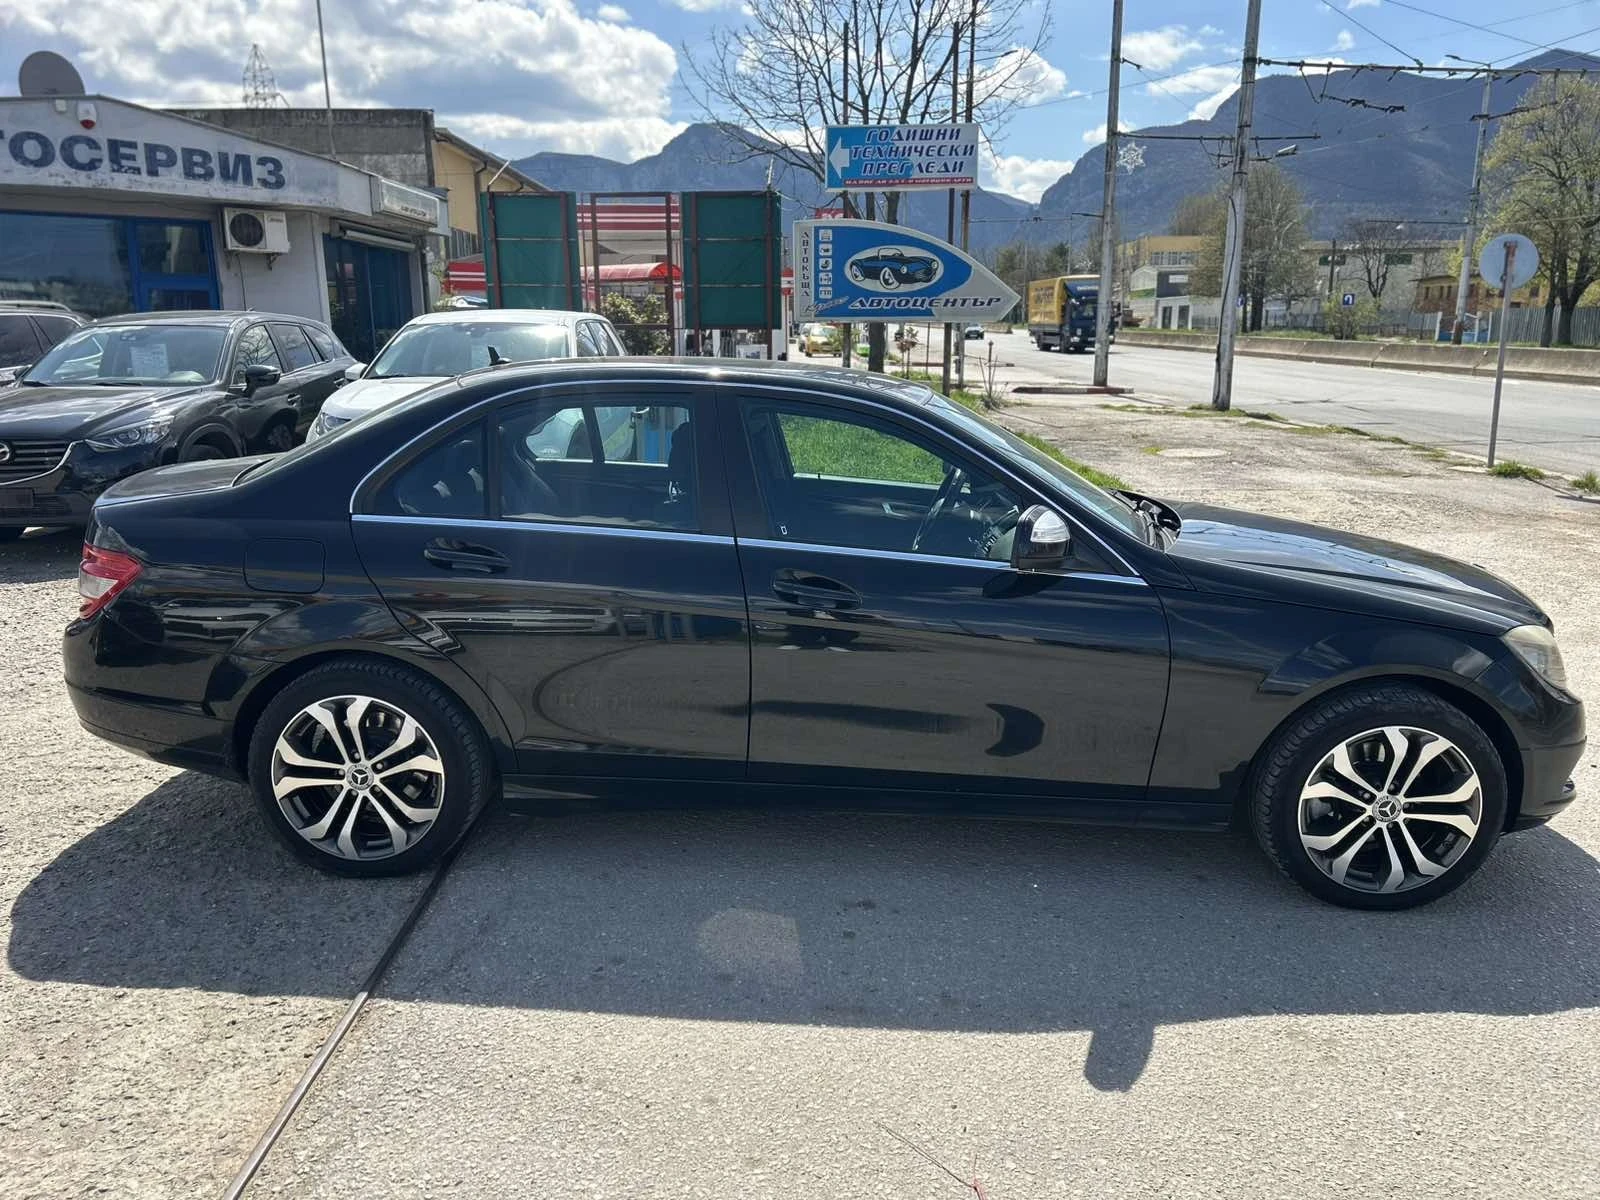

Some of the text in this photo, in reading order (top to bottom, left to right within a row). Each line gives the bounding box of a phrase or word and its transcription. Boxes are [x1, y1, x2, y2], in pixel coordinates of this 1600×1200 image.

[865, 128, 961, 143] ГОДИШНИ
[851, 144, 975, 159] ТЕХНИЧЕСКИ
[0, 130, 286, 190] ОСЕРВИЗ
[849, 296, 1001, 310] АВТОЦЕНТЪР
